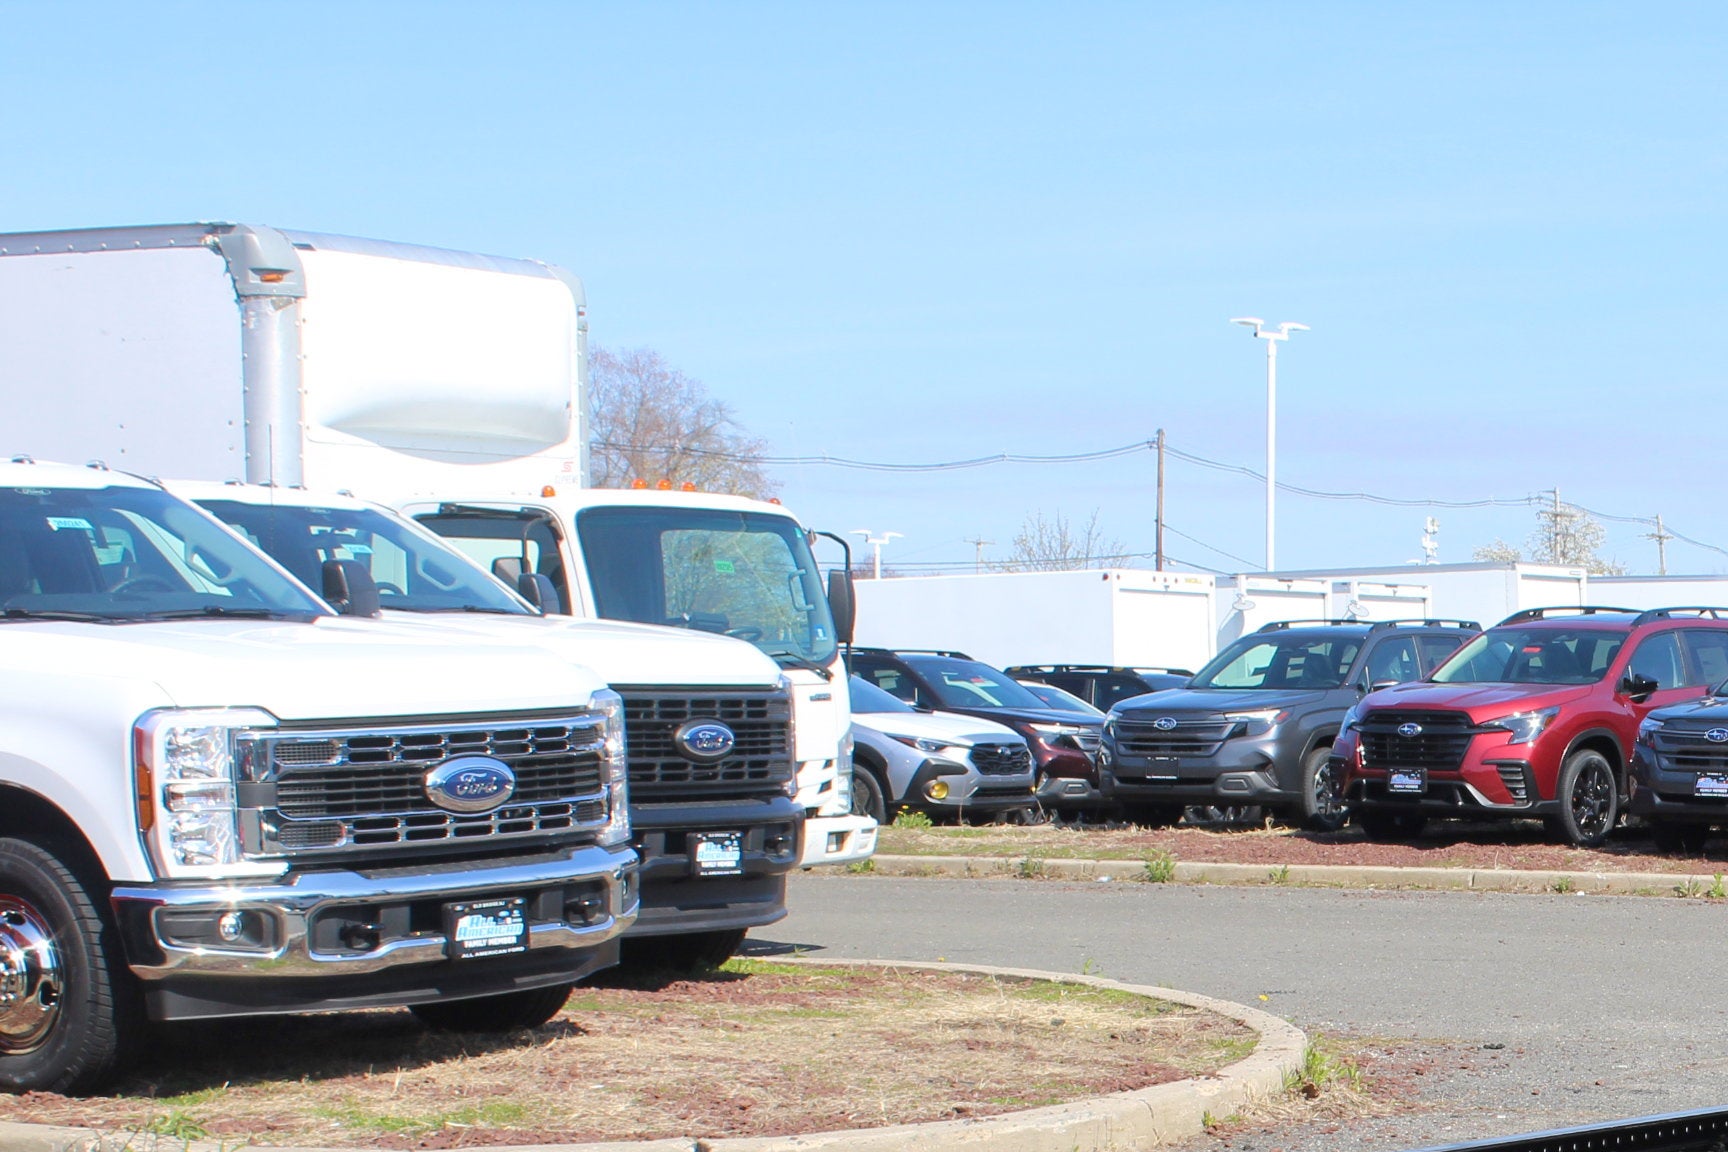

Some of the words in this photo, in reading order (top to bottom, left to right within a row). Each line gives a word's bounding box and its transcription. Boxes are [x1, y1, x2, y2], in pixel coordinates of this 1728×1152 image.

[697, 731, 724, 749] Ford
[456, 772, 498, 796] Ford
[468, 914, 497, 928] ALL
[456, 923, 524, 939] AMERICAN
[464, 940, 488, 949] FAMILY
[488, 936, 517, 946] MEMBER
